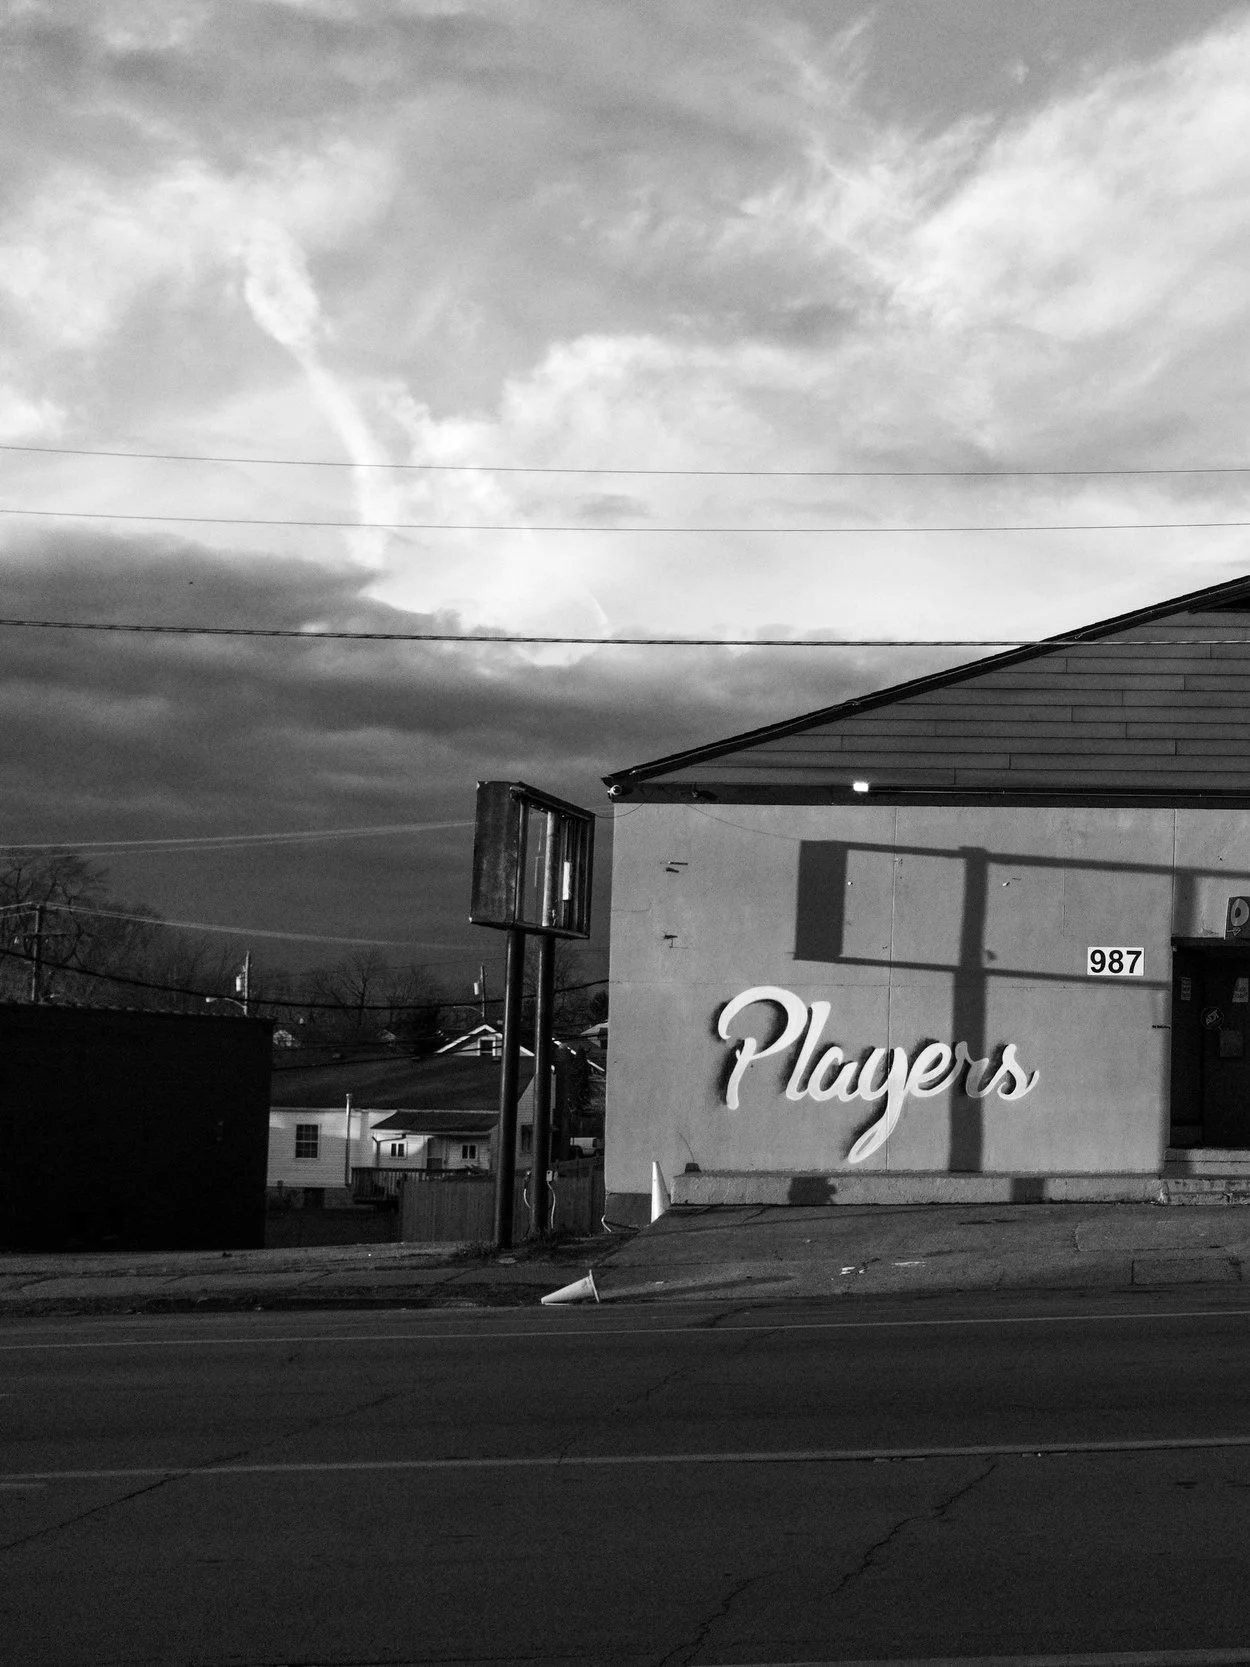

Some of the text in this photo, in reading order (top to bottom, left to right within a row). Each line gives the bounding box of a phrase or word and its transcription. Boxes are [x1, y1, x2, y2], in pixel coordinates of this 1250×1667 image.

[1090, 949, 1142, 974] 987
[1205, 1009, 1219, 1025] ADT
[717, 985, 1040, 1164] Players
